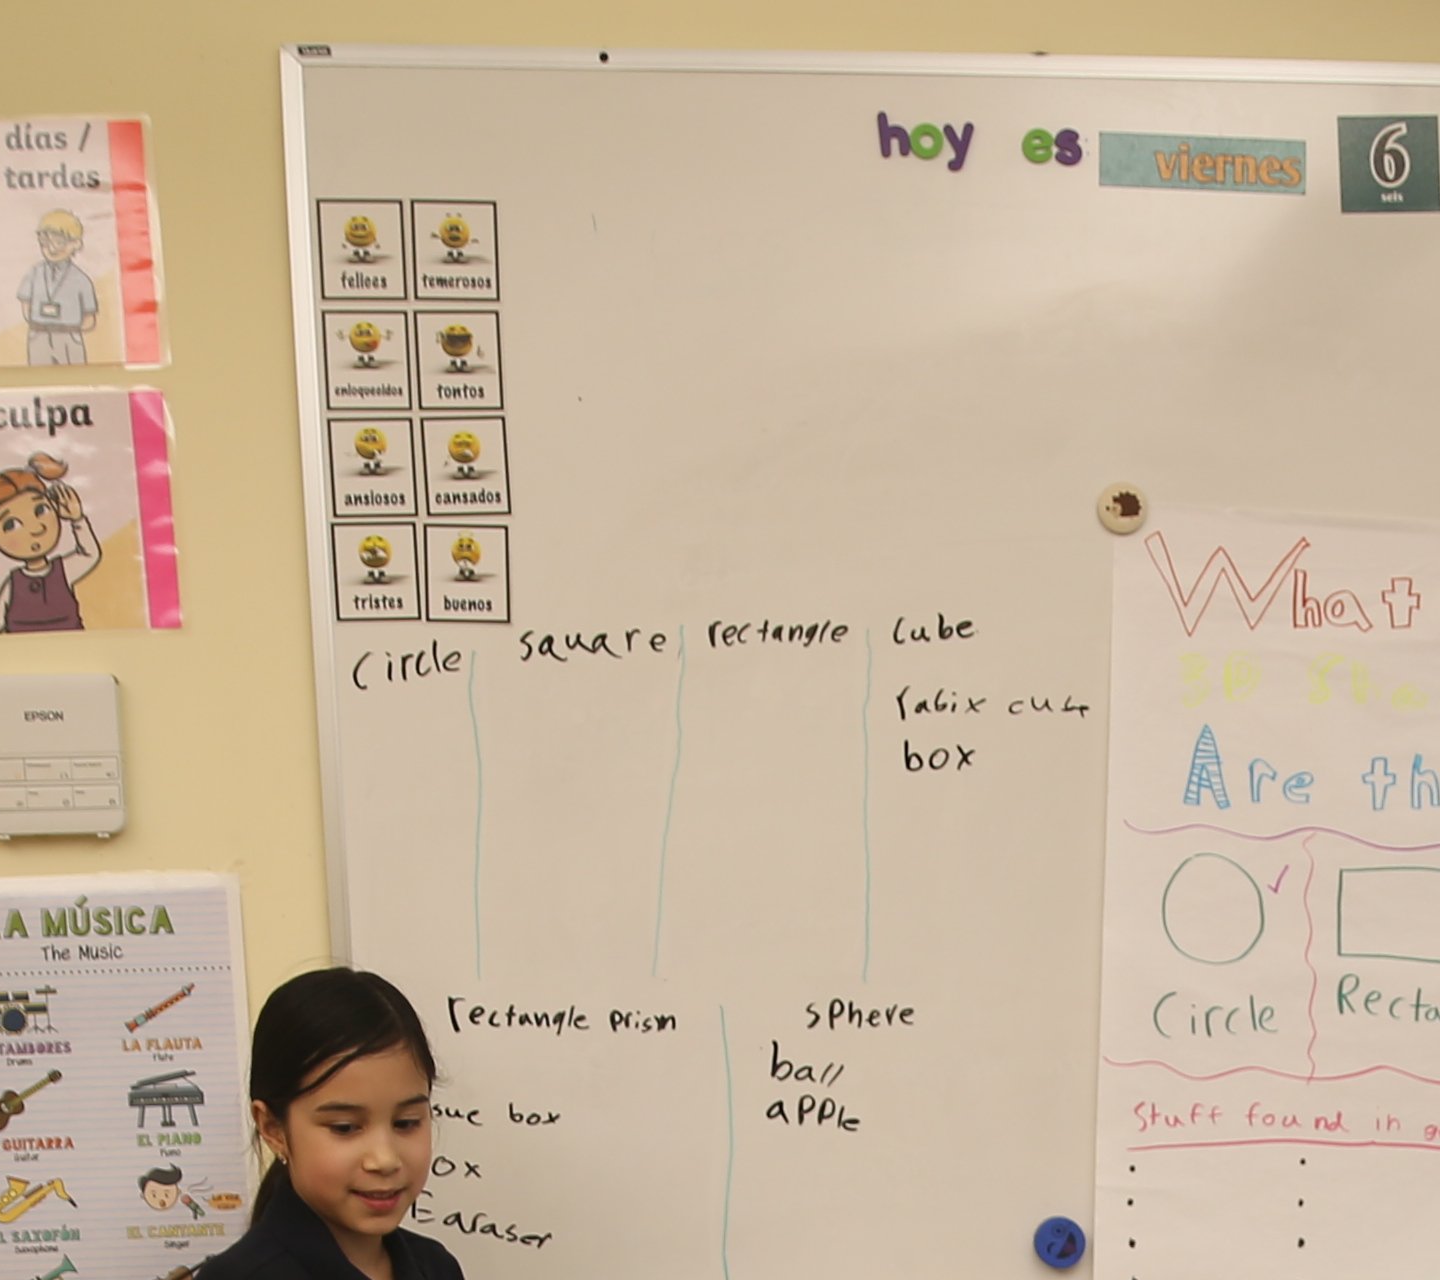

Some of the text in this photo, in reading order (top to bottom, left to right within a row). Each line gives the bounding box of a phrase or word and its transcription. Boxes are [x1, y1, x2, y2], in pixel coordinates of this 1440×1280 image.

[4, 123, 69, 154] días
[876, 110, 974, 172] hoy
[1021, 127, 1084, 167] es
[1153, 143, 1303, 189] viernes
[1366, 119, 1411, 192] 6
[3, 162, 102, 194] tardes
[421, 272, 492, 290] temerosos
[437, 383, 486, 401] tontos
[435, 488, 502, 506] cansados
[1143, 530, 1422, 638] What
[352, 594, 404, 612] tristes
[443, 594, 493, 613] buenos
[707, 617, 849, 651] rectangle
[23, 710, 64, 723] EPSON
[903, 739, 977, 772] box
[1182, 724, 1316, 811] Are
[41, 894, 176, 937] MÚSICA
[40, 943, 124, 963] The Music
[508, 1101, 562, 1126] box
